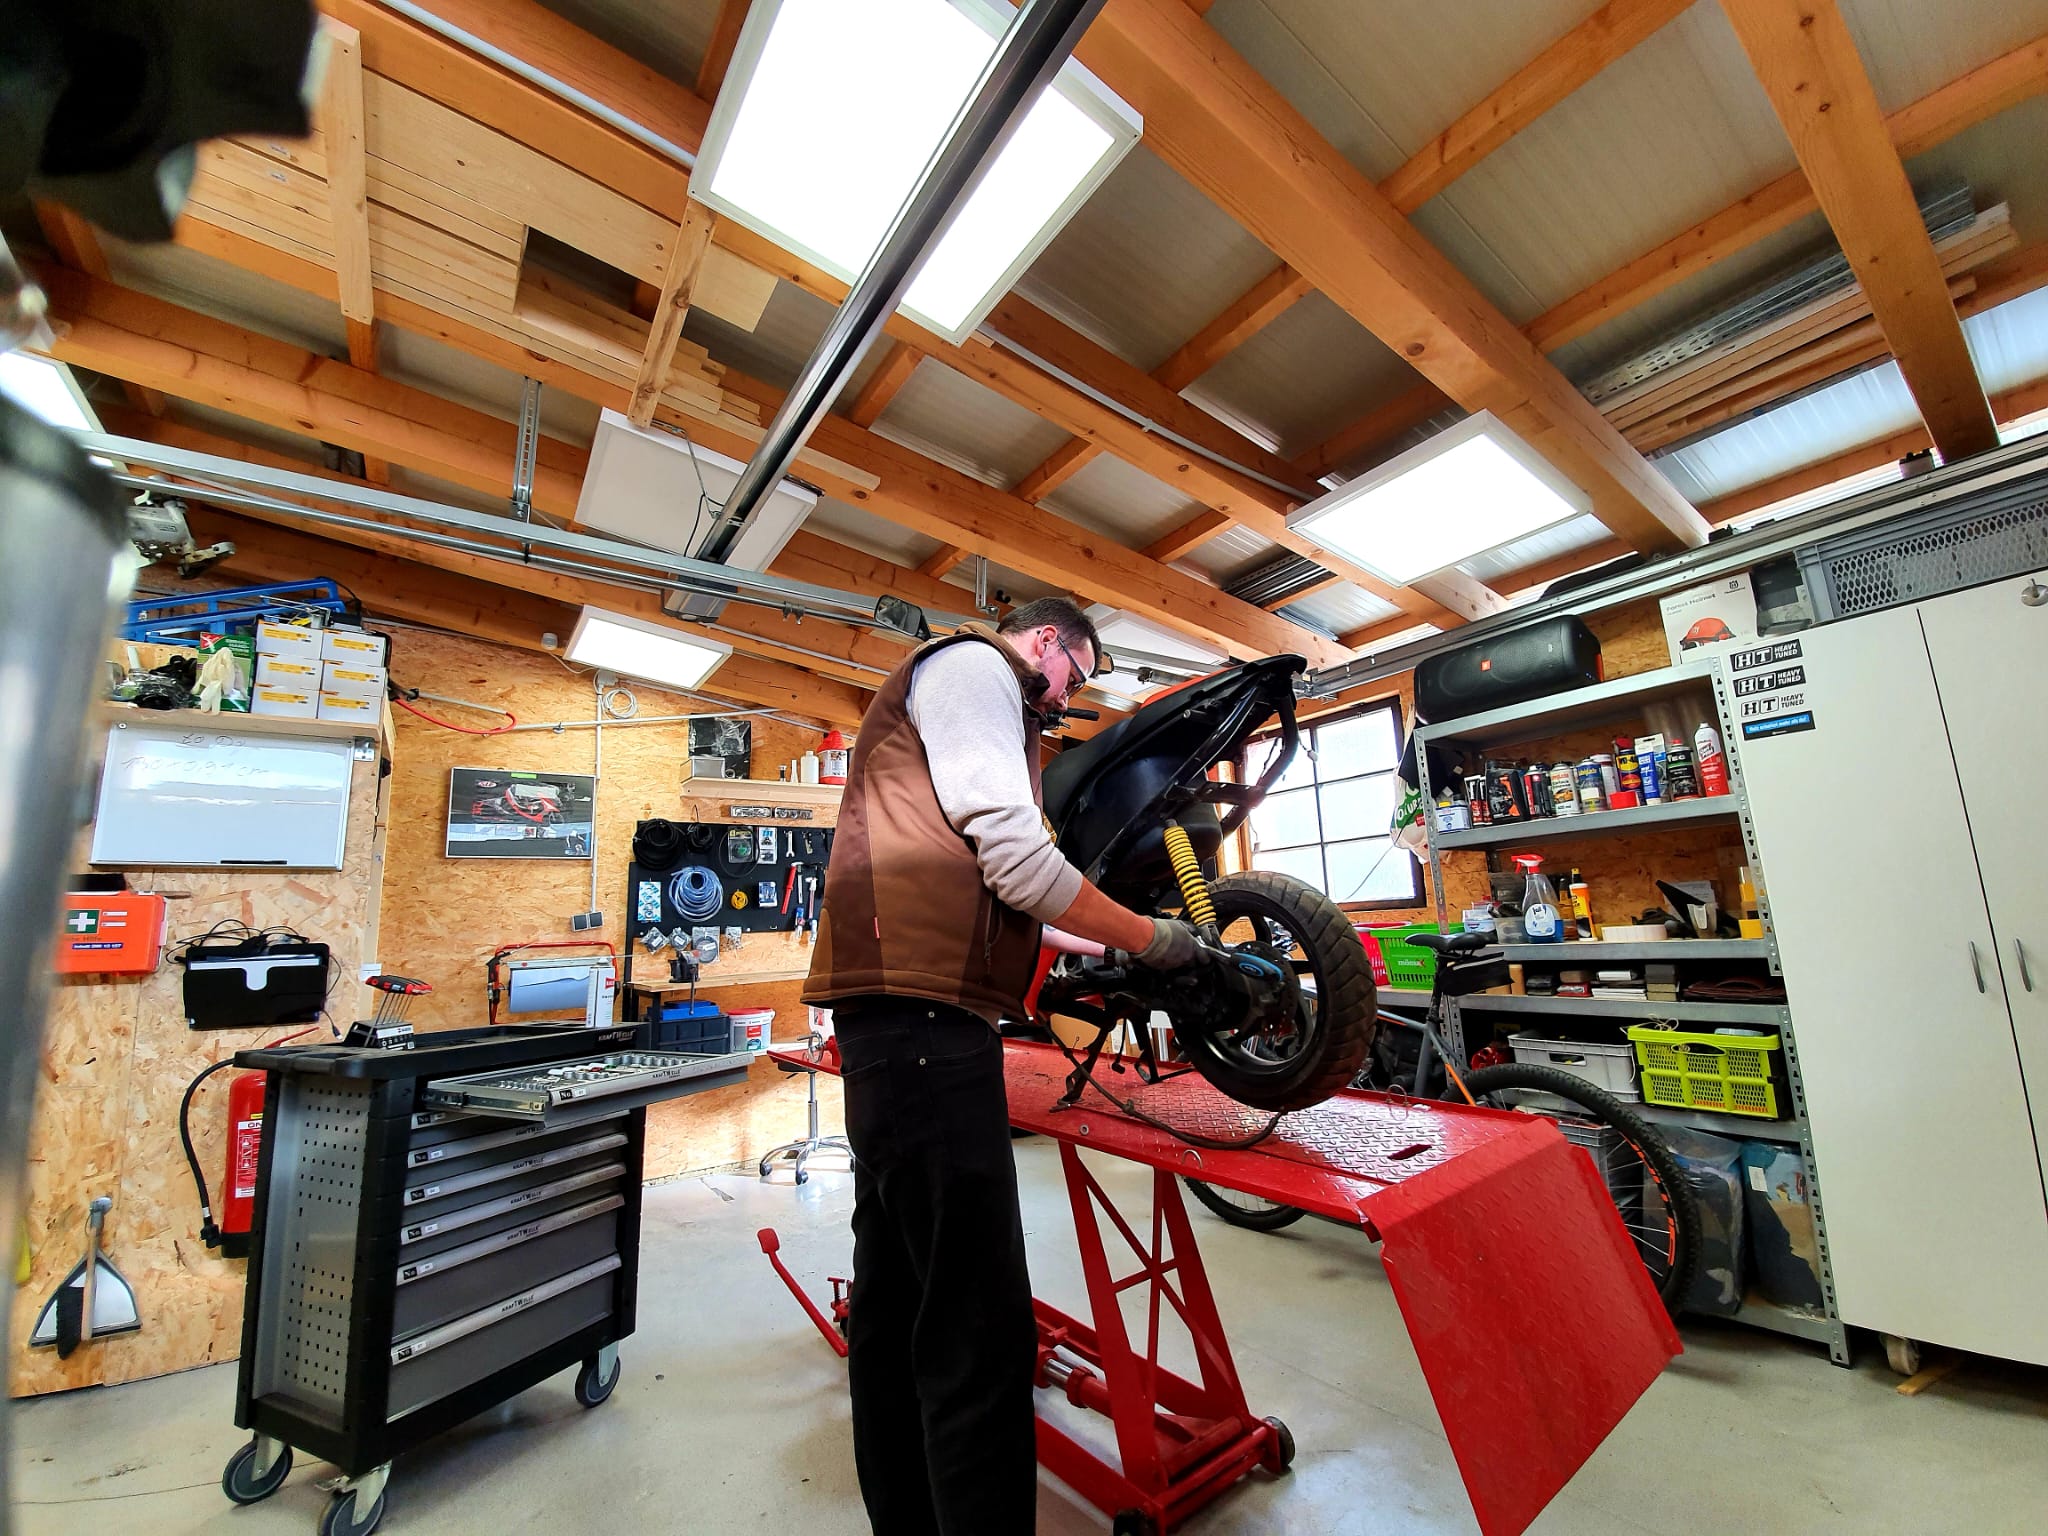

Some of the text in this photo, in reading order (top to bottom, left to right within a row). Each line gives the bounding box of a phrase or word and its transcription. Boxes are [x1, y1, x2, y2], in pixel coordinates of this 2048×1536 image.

[1774, 642, 1798, 654] HEAVY
[1775, 648, 1798, 659] TUNED
[1737, 648, 1771, 668] HT
[1777, 669, 1801, 680] HEAVY
[1778, 675, 1802, 685] TUNED
[1739, 674, 1774, 694] HT
[1780, 692, 1804, 703] HEAVY
[1743, 698, 1776, 716] HT
[1781, 699, 1805, 709] TUNED
